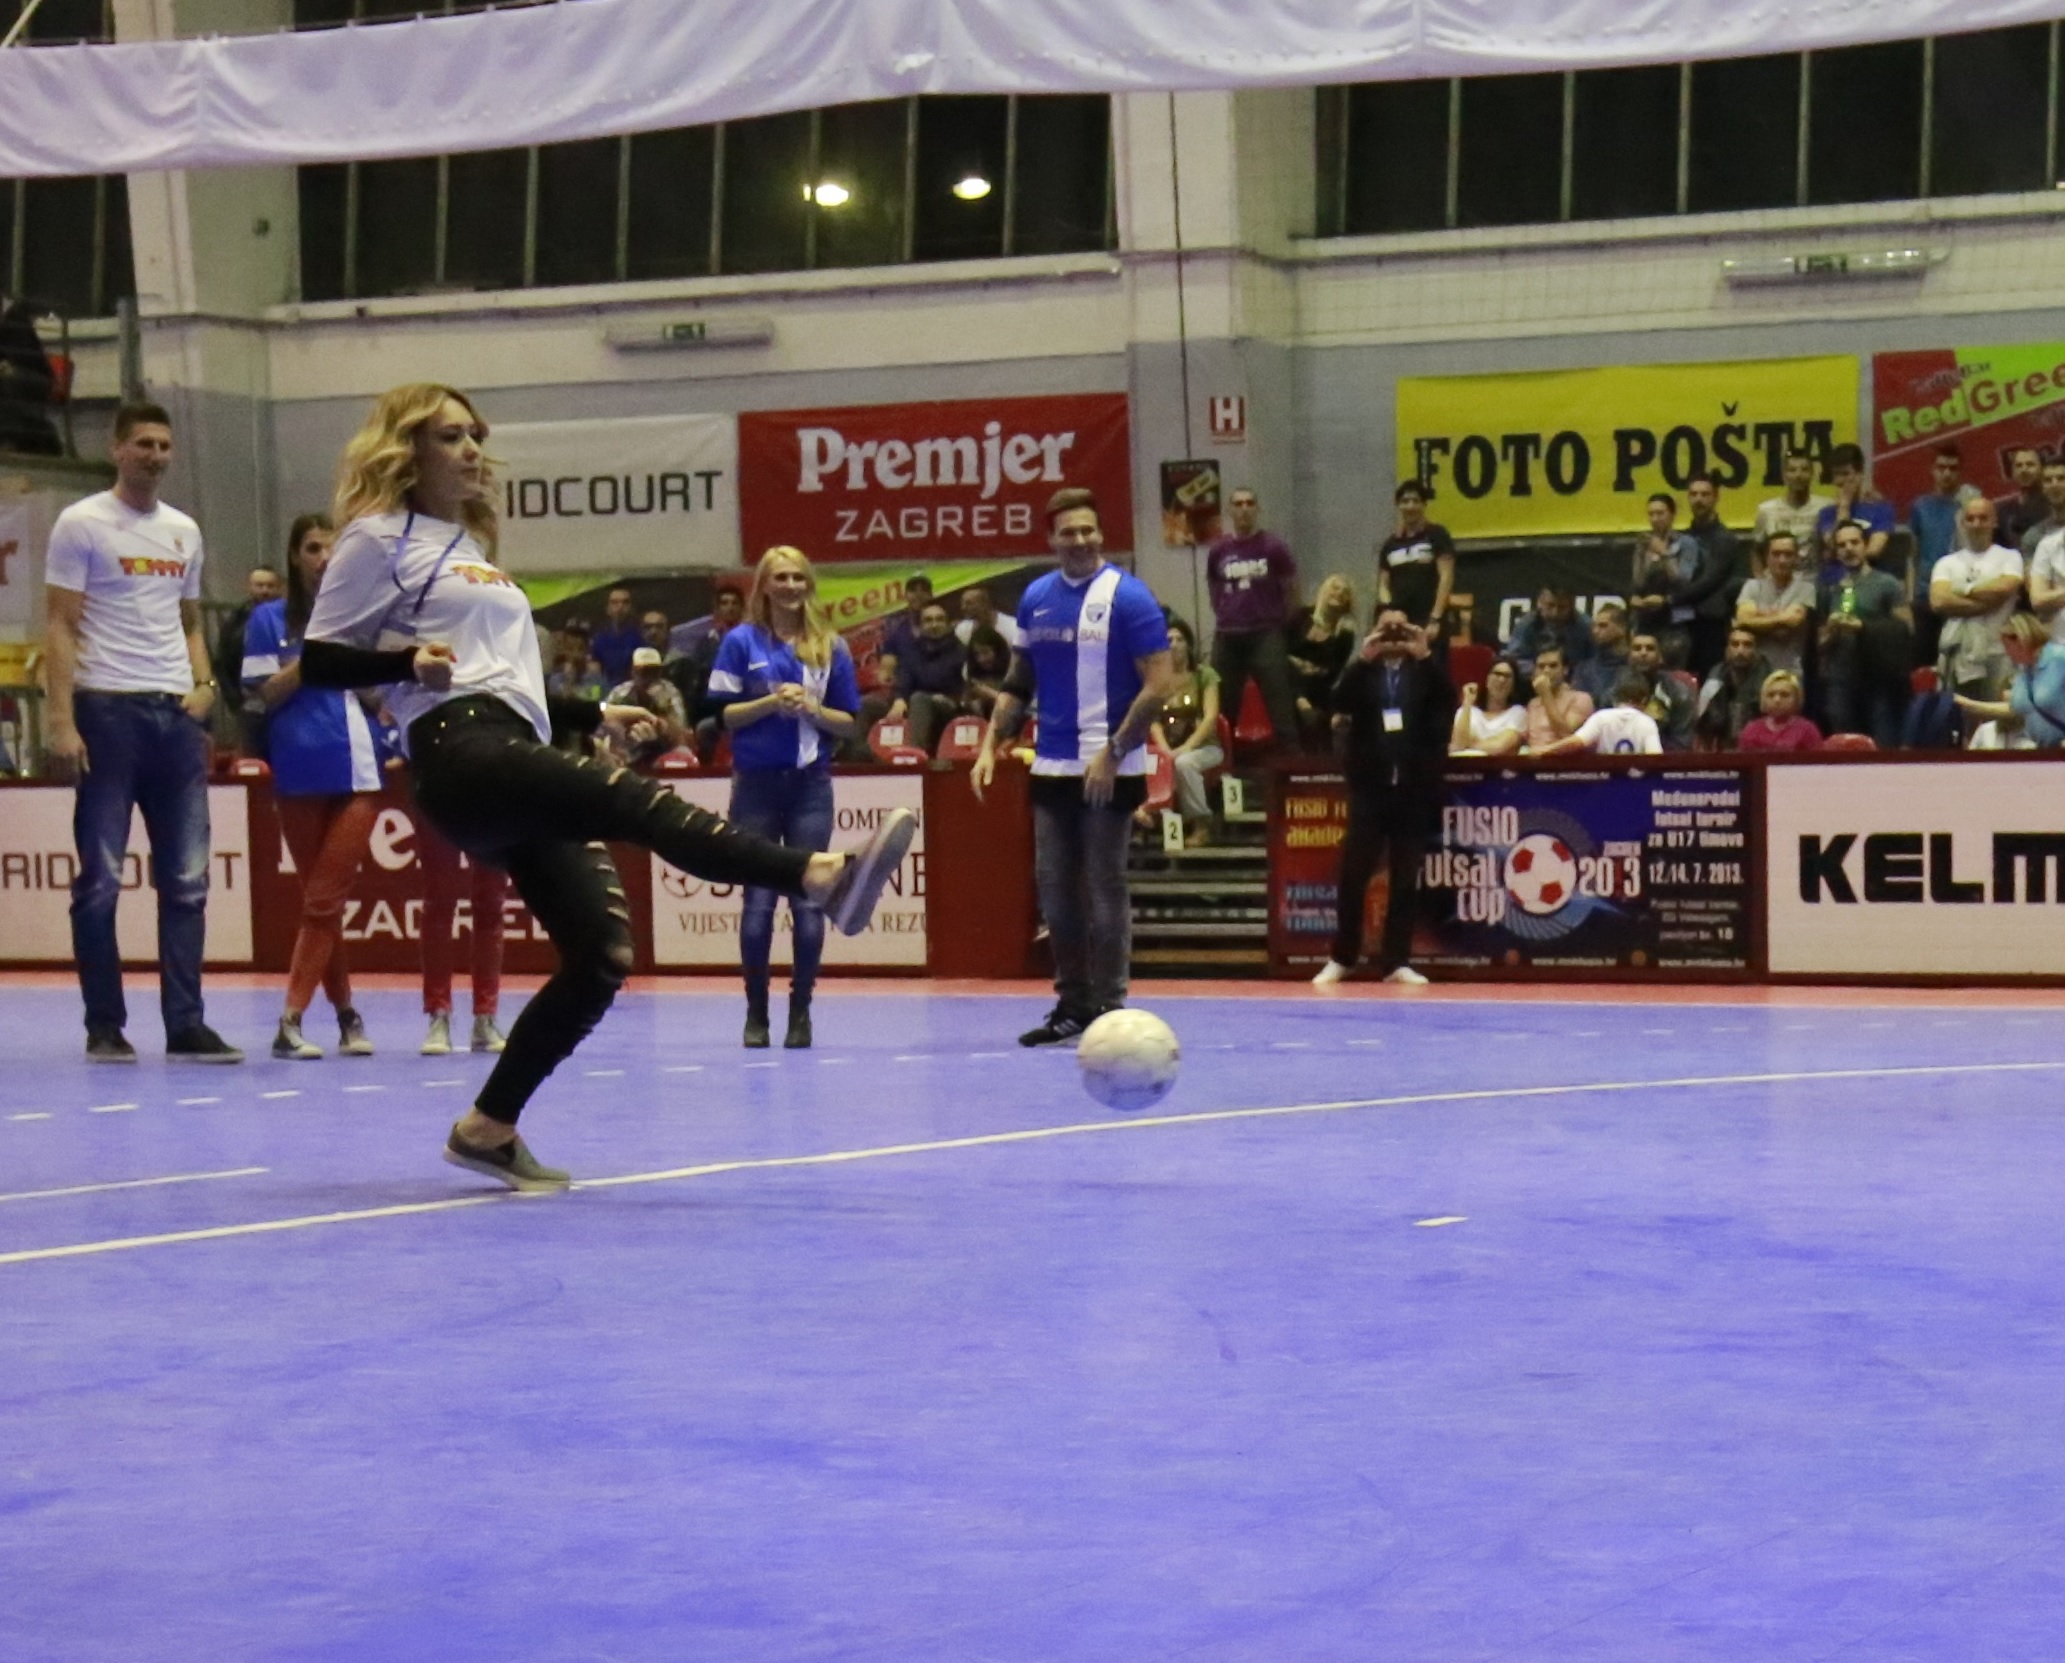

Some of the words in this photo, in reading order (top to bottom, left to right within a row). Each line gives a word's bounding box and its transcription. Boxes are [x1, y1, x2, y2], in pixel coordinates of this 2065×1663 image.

[1215, 398, 1240, 431] H
[797, 421, 1075, 500] Premjer
[1414, 430, 1590, 500] FOTO
[1613, 401, 1833, 492] POŠTA
[835, 503, 1032, 542] ZAGREB
[1229, 785, 1238, 804] 3
[1168, 821, 1178, 841] 2
[1443, 806, 1518, 847] FUSIO
